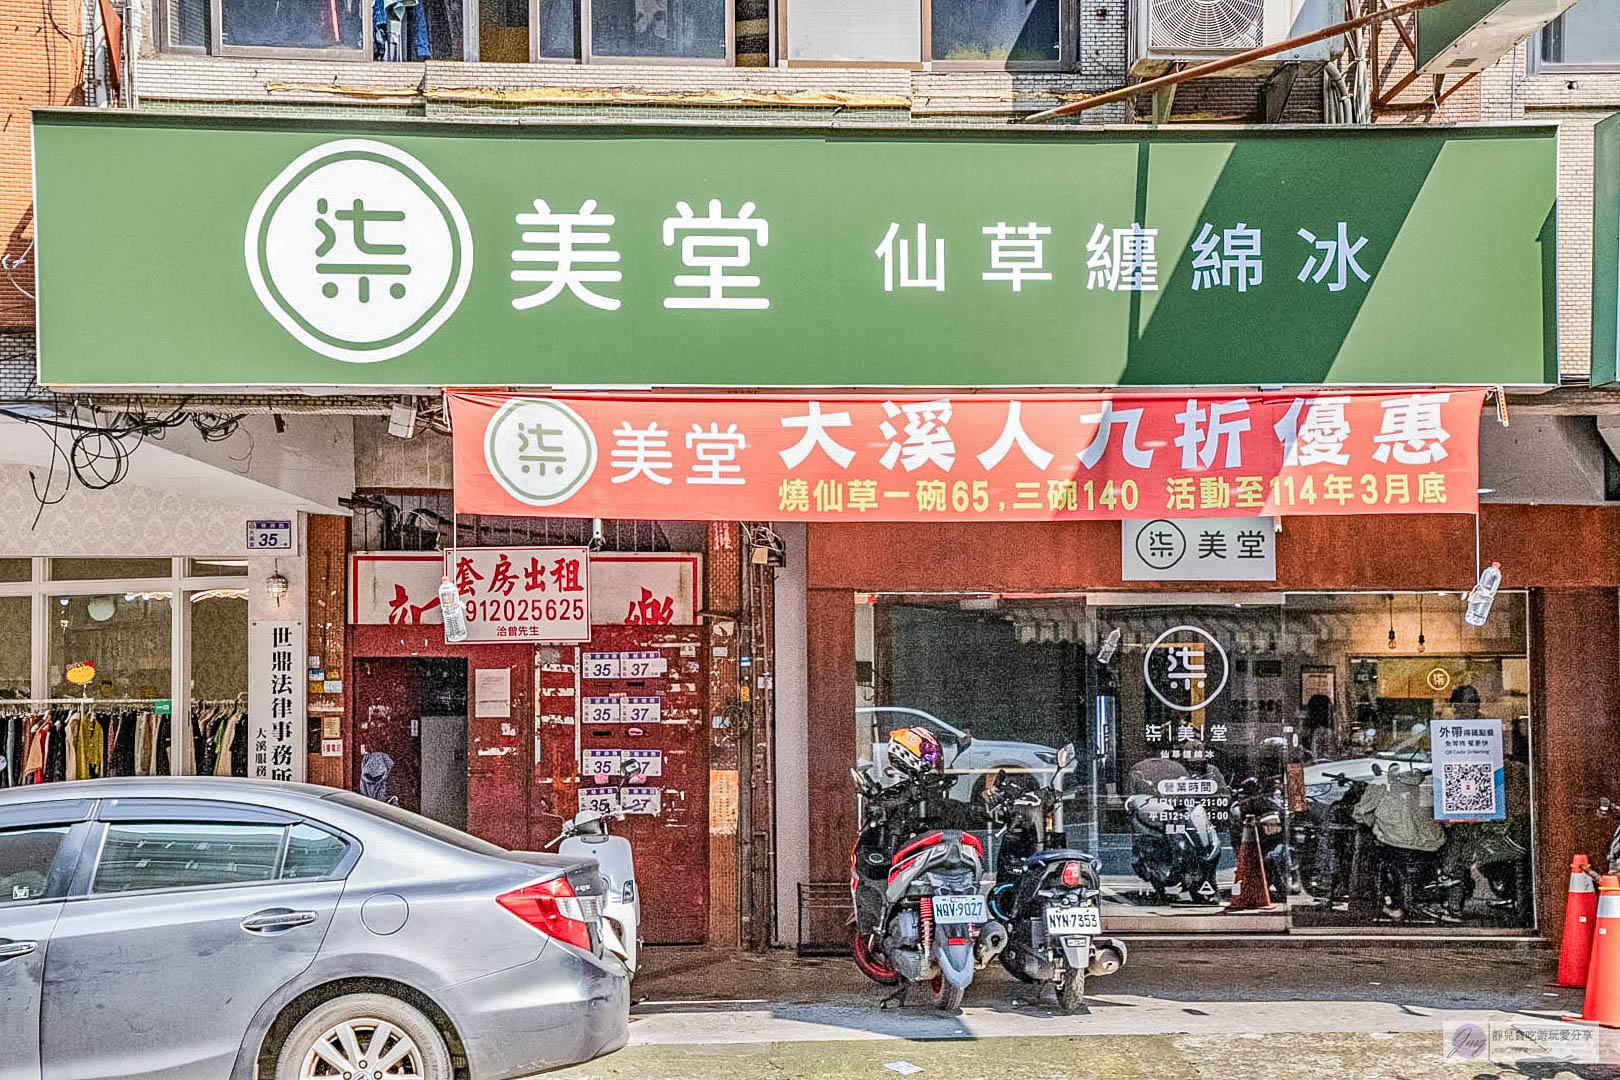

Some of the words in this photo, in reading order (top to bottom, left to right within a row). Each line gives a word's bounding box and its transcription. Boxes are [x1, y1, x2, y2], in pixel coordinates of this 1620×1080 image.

[874, 221, 1372, 293] 仙草纏綿冰
[778, 393, 1451, 473] 大溪人九折優惠
[1165, 472, 1449, 511] 活動至114年3月底
[258, 533, 278, 547] 35
[454, 554, 584, 597] 套房出租
[464, 598, 584, 622] 912025625
[593, 664, 611, 676] 35
[631, 663, 649, 676] 37
[271, 627, 293, 781] 世鼎法律事務所
[593, 708, 611, 721] 35
[631, 708, 649, 721] 37
[594, 761, 611, 773] 35
[1164, 782, 1211, 793] 營業時間
